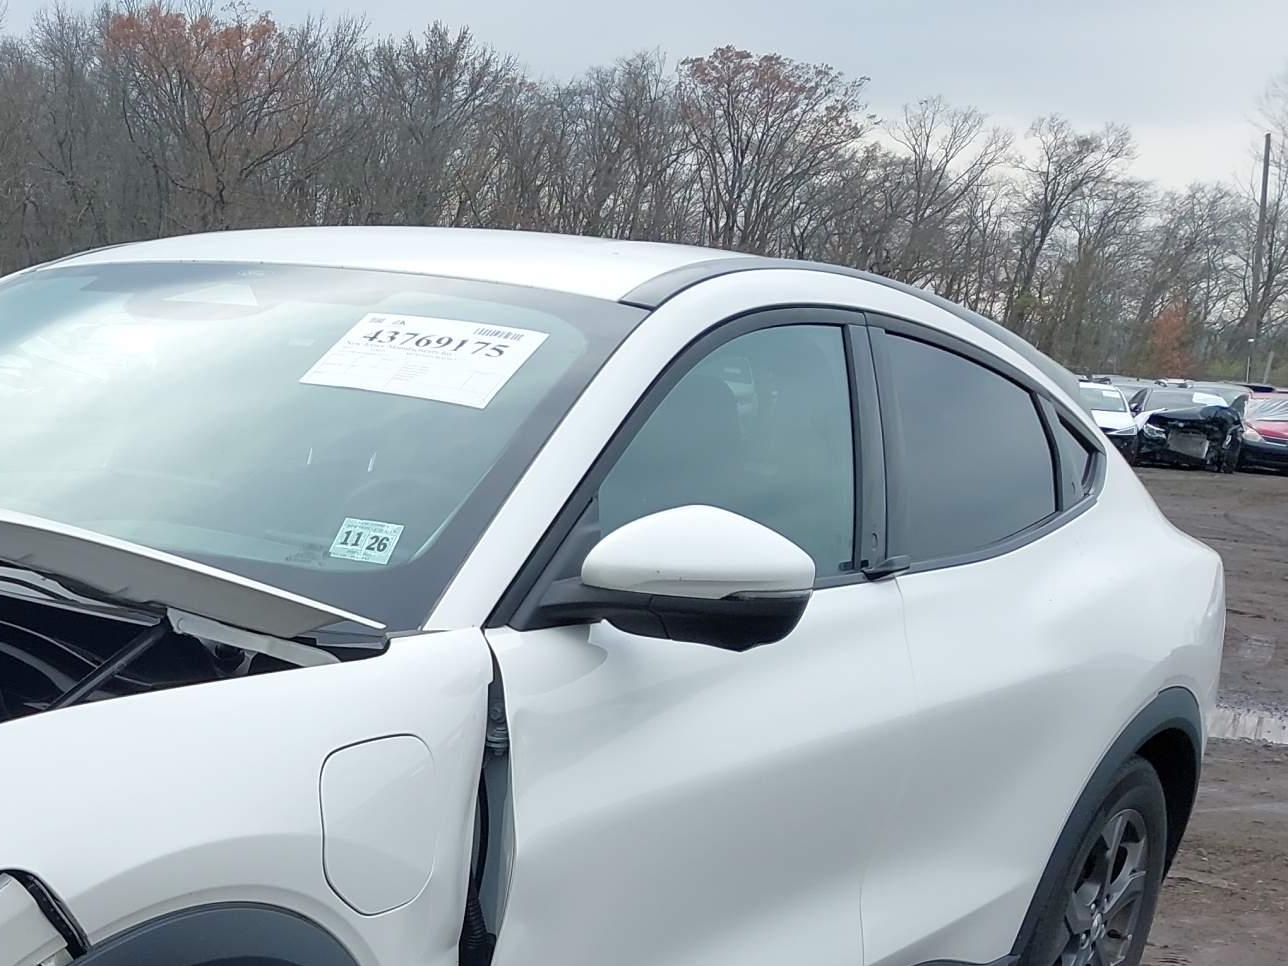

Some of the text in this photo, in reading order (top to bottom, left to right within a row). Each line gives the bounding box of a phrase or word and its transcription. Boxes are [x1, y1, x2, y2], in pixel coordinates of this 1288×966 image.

[362, 329, 511, 358] 43769175
[340, 530, 390, 552] 11 26
